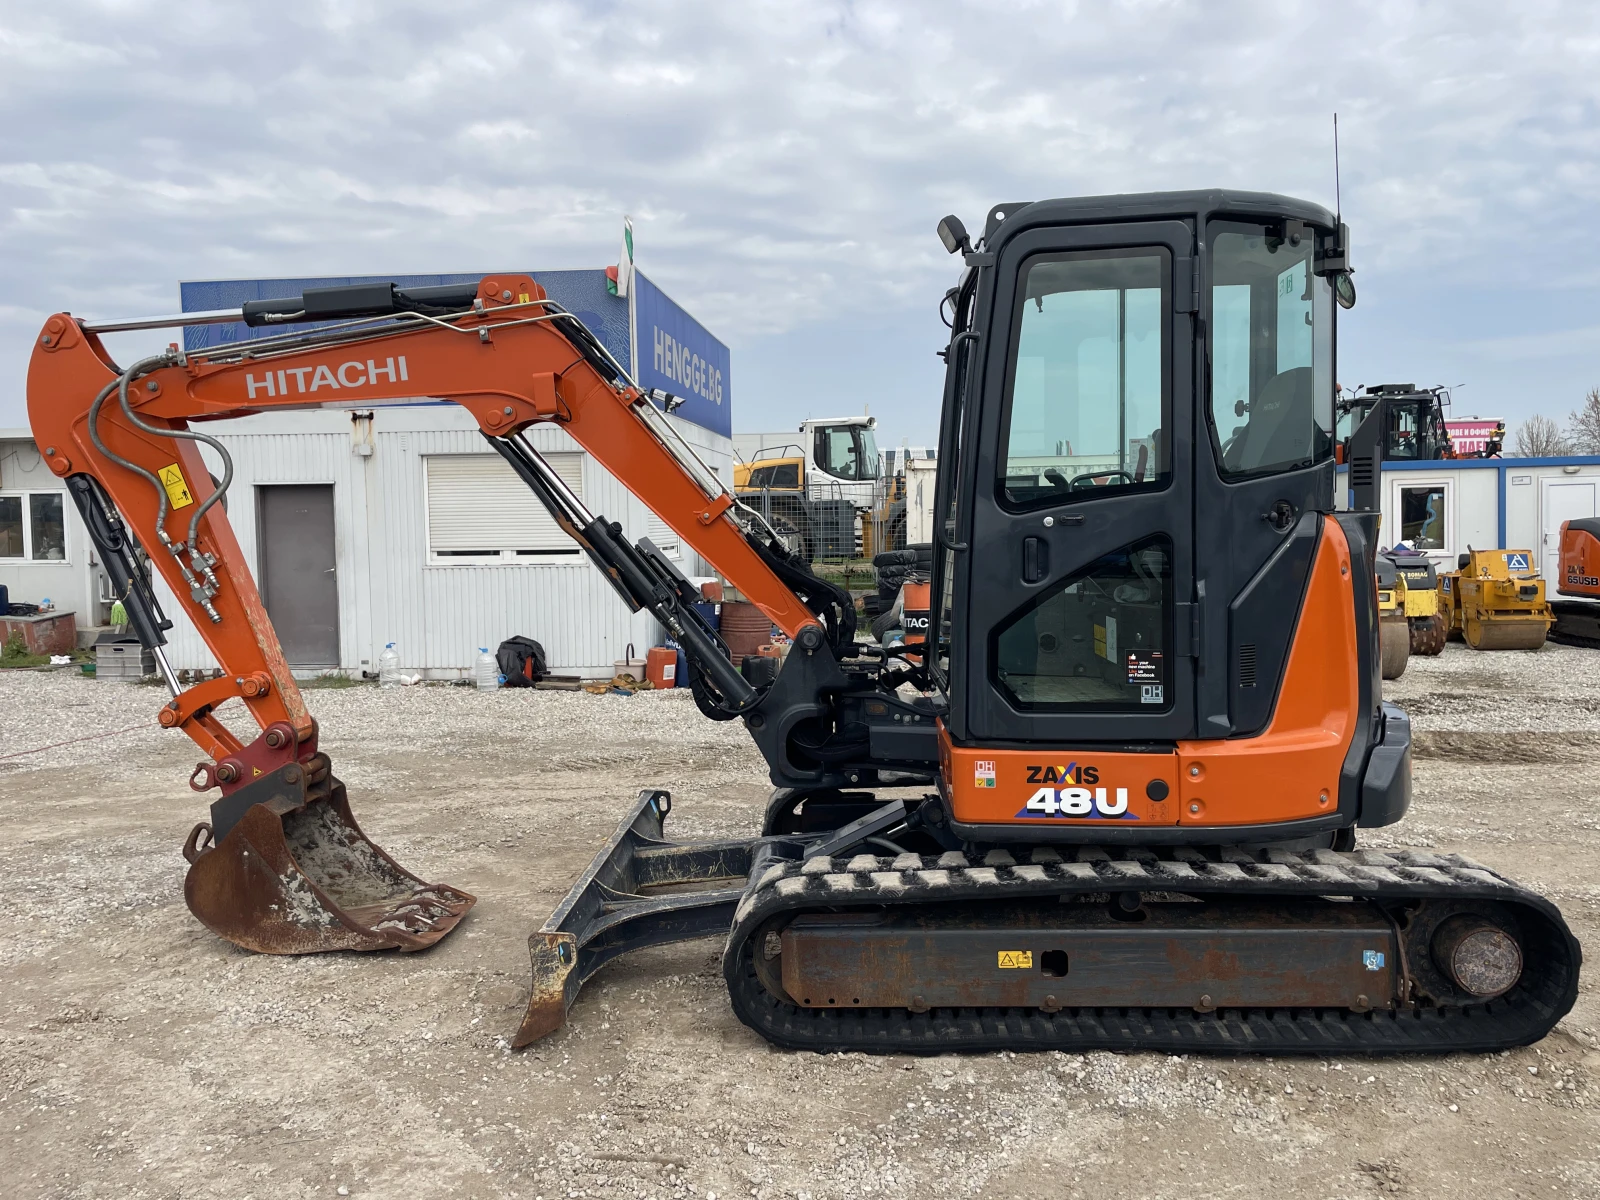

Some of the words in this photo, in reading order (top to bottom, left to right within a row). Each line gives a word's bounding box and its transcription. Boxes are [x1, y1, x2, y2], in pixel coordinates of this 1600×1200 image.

[246, 356, 409, 399] HITACHI
[654, 325, 722, 406] HENGGE.BG
[1567, 575, 1599, 586] 65USB
[1026, 762, 1100, 785] ZAXIS
[1026, 787, 1128, 819] 48U
